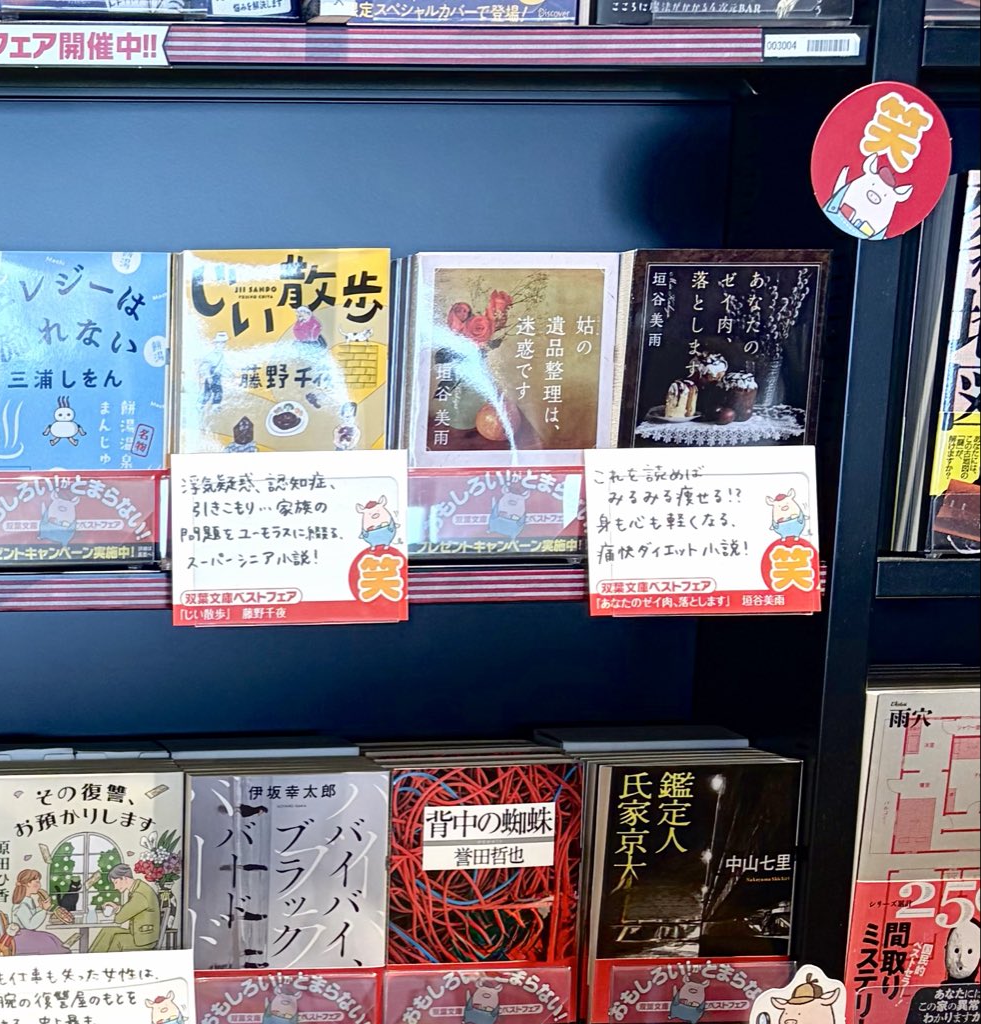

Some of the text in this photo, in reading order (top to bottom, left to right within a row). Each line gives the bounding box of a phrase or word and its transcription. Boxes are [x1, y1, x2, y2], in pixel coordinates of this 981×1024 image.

[766, 41, 798, 52] 003004
[862, 94, 931, 170] 笑
[647, 271, 669, 348] 垣谷美雨
[743, 270, 766, 357] あなたの
[575, 315, 599, 357] 姑の
[514, 315, 537, 401] 迷惑です
[7, 367, 123, 390] 三浦しをん
[542, 316, 567, 432] 遺品整理は、
[133, 427, 151, 454] 名物
[181, 471, 336, 495] 浮気疑惑、認知症、
[593, 464, 706, 485] これを読めば
[607, 486, 743, 507] みるみる痩せる!?
[187, 549, 319, 570] スーパーシニア小説!
[596, 538, 750, 565] 痛快ダイエット小説!
[359, 555, 404, 602] 笑
[770, 546, 815, 592] 笑
[184, 591, 298, 605] 双葉文庫ベストフェア
[600, 580, 712, 594] 双葉文庫ベストフェア
[242, 607, 288, 620] 藤野千夜
[595, 594, 786, 610] 『あなたのゼイ肉、落とします』 垣谷美雨
[888, 706, 933, 730] 雨穴
[35, 782, 137, 807] その復讐、
[248, 783, 338, 800] 伊坂幸太郎
[14, 809, 157, 838] お預かりします
[425, 806, 554, 840] 背中の蜘蛛
[656, 772, 697, 856] 鑑定人
[452, 845, 526, 867] 誉田哲也
[724, 852, 792, 874] 中山七里
[271, 817, 316, 958] ブラック
[323, 817, 365, 968] バイバイ、
[895, 880, 981, 930] 25
[880, 921, 912, 1001] 間取り
